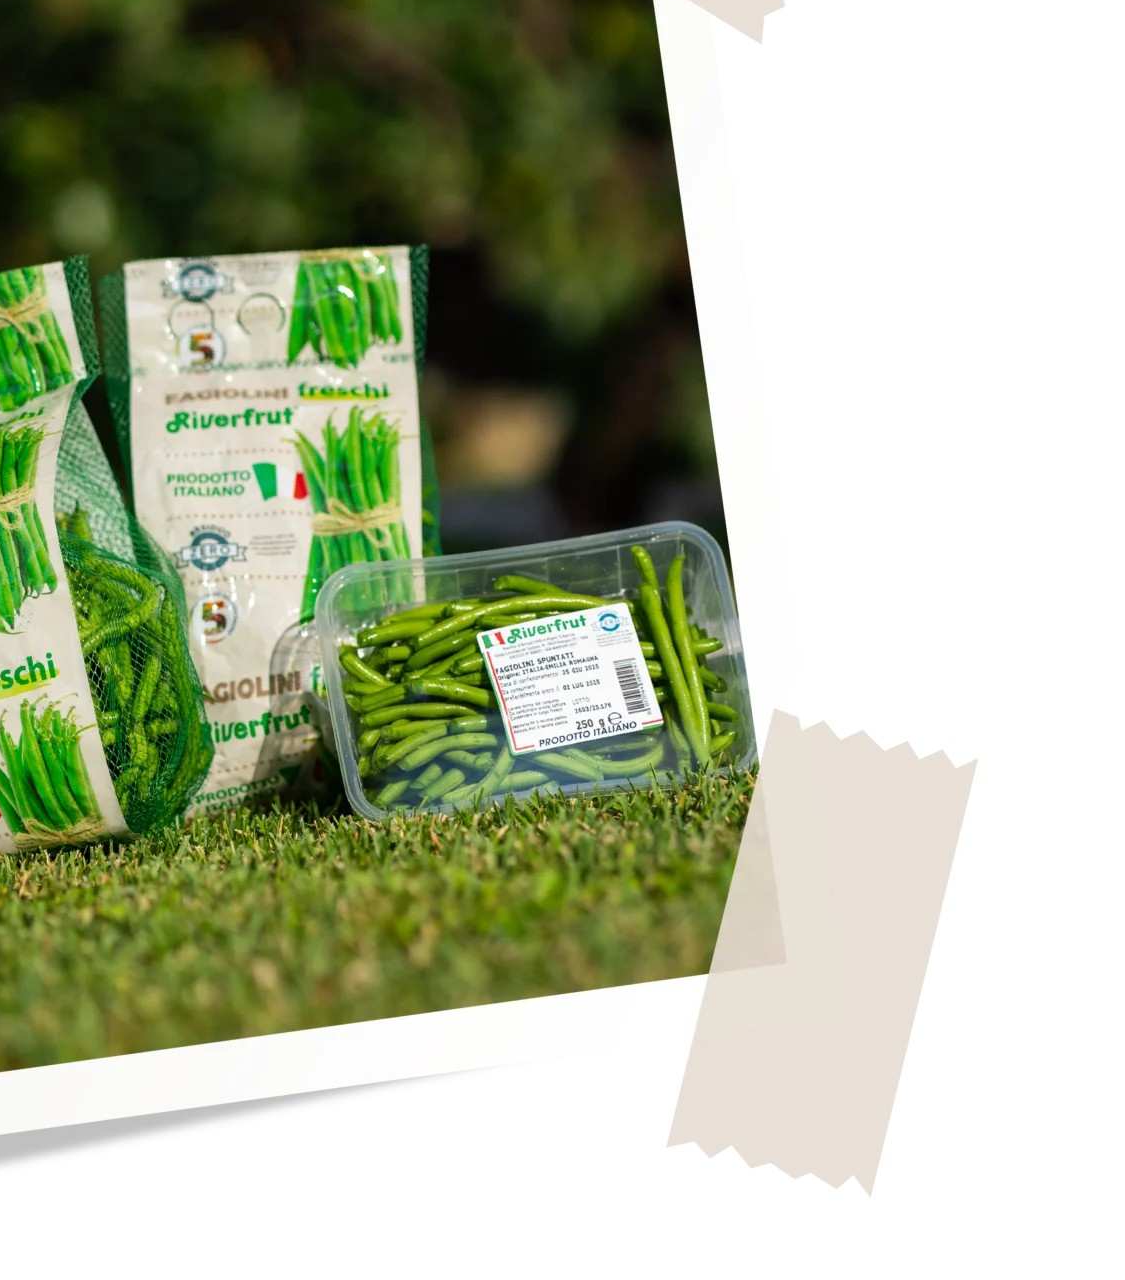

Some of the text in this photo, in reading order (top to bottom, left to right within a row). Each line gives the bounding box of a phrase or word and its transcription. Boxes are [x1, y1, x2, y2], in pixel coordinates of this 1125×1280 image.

[165, 382, 389, 405] FAGIOLINI freschi
[166, 407, 293, 433] Riverfrut
[166, 470, 251, 484] PRODOTTO
[174, 484, 245, 497] ITALIANO
[190, 544, 231, 559] ZERO
[507, 615, 587, 645] Riverfrut
[495, 651, 574, 675] FAGIOLINI SPUNTATI
[522, 660, 567, 676] ITALIA-EMILIA
[568, 655, 599, 666] ROMAGNA
[572, 666, 583, 674] GIU
[585, 664, 600, 672] 2025
[586, 679, 601, 687] 2025
[538, 721, 638, 748] PRODOTTO ITALIANO
[575, 718, 594, 731] 250
[195, 775, 280, 805] PRODOTTO
